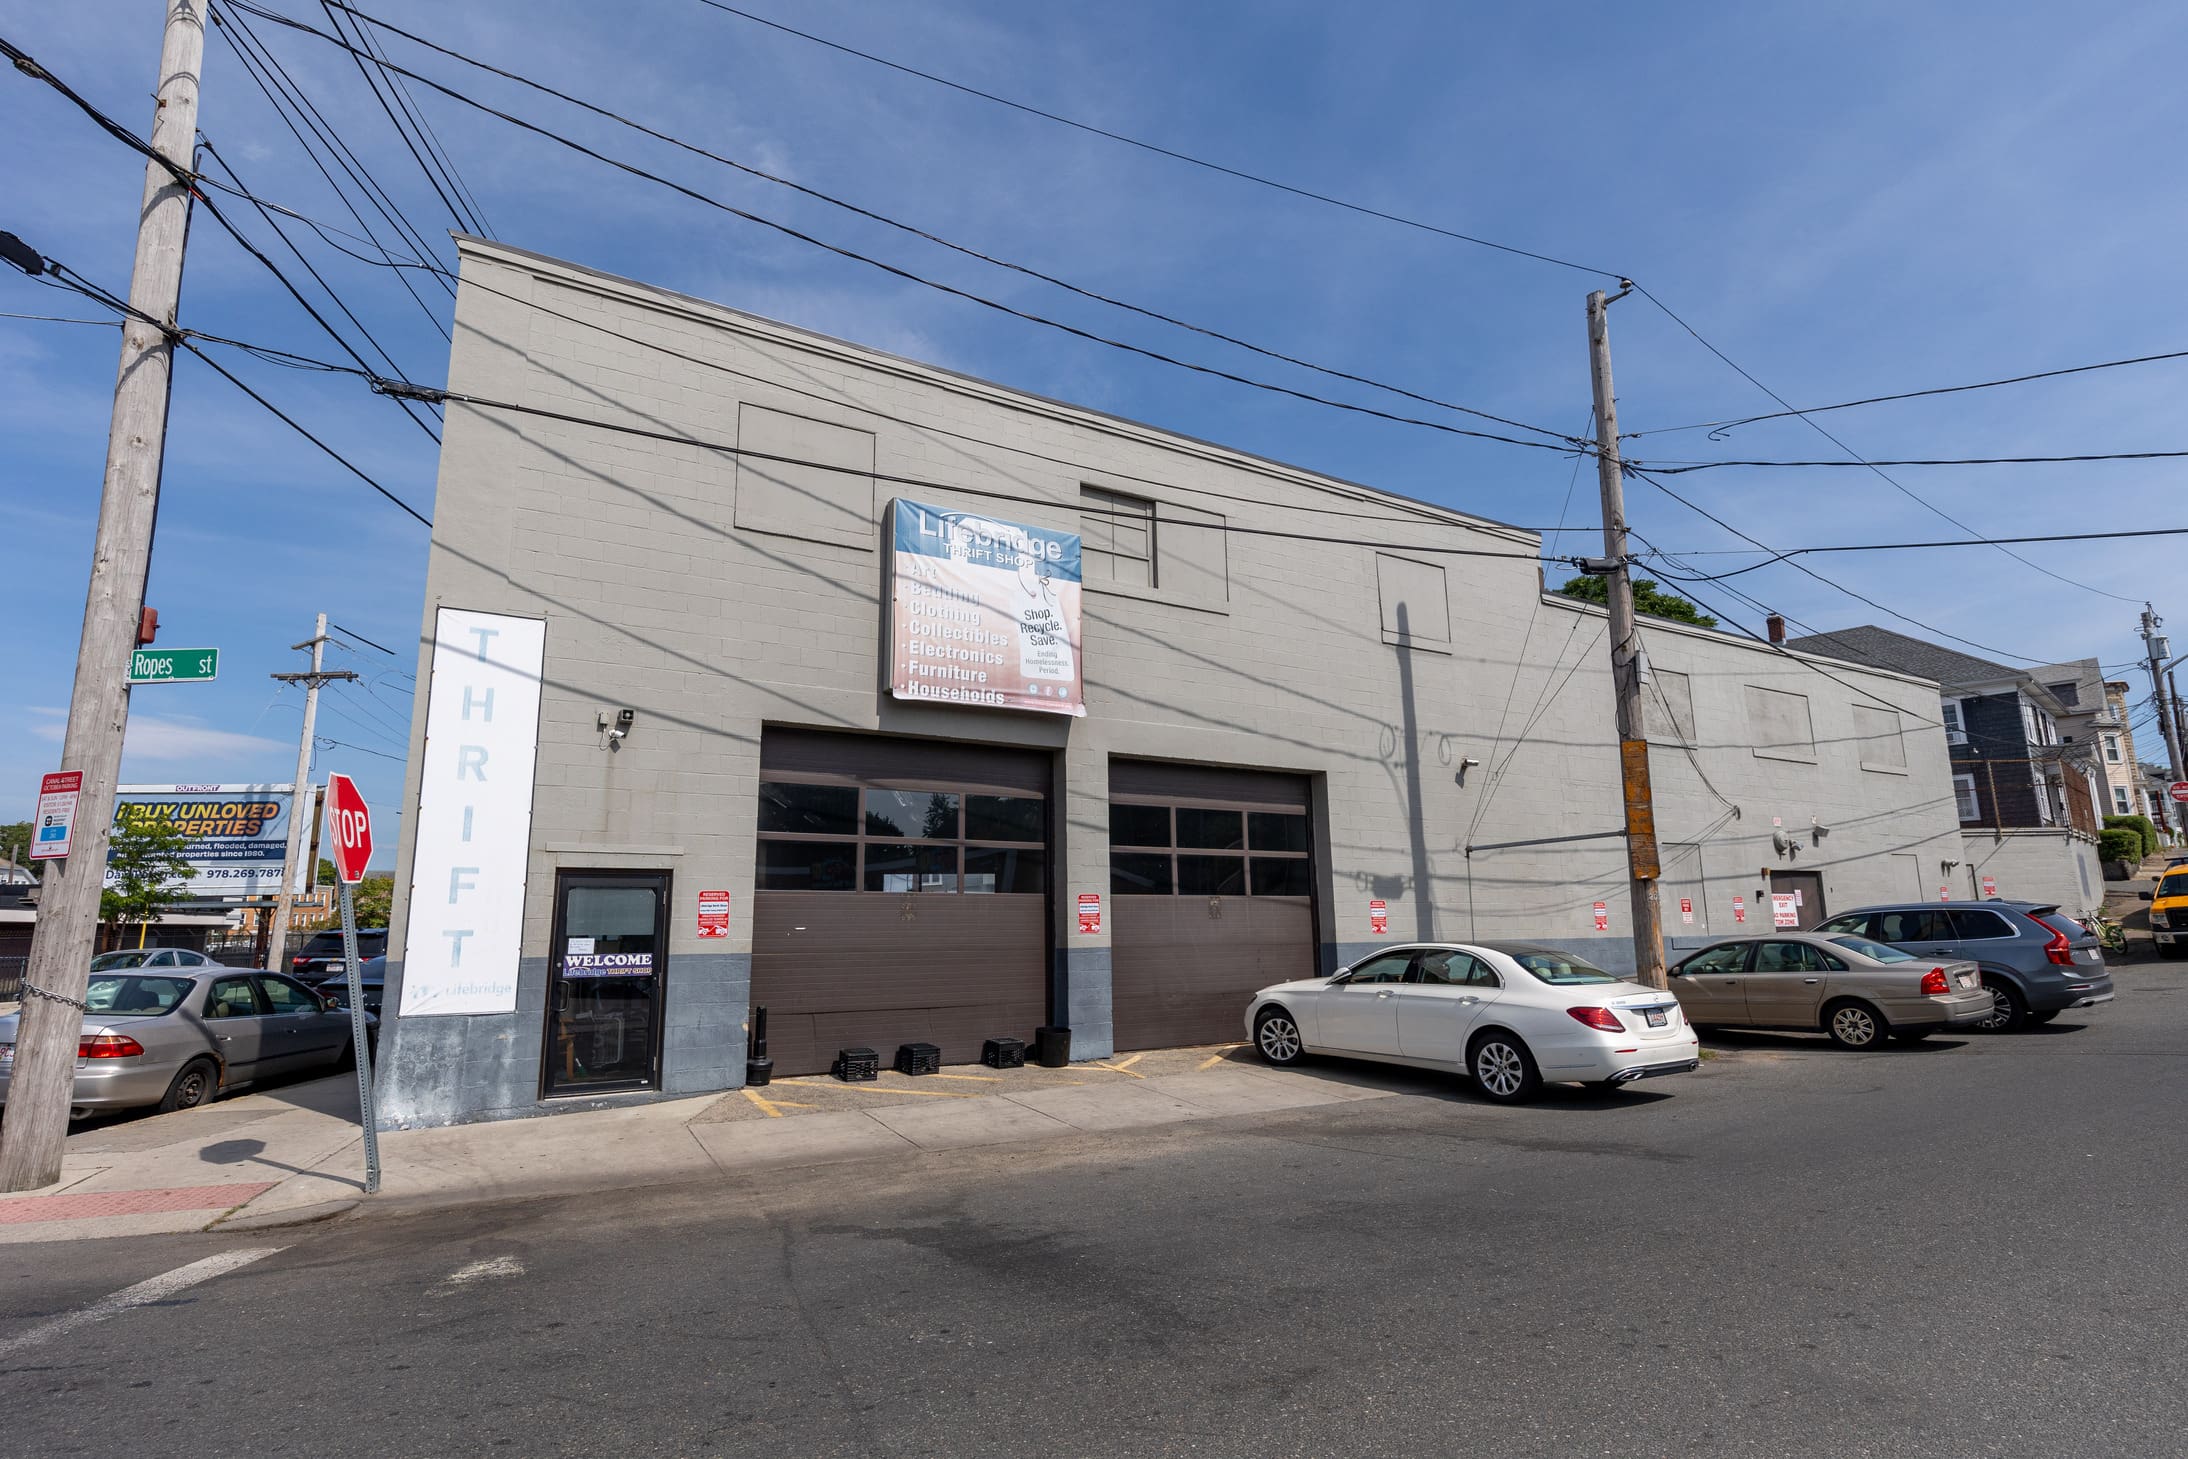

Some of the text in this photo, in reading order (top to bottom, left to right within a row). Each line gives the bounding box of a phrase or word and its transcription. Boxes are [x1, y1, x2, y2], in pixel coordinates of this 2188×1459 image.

[919, 509, 1063, 561] Lifebridge
[943, 542, 1034, 569] THRIFT SHOP
[912, 562, 937, 579] Art
[911, 582, 981, 606] Bedding
[910, 601, 982, 626] Clothing
[1024, 609, 1054, 624] Shop.
[909, 620, 1009, 647] Collectibles
[1020, 621, 1063, 636] Recycle.
[1031, 634, 1058, 647] Save.
[909, 641, 1004, 666] Electronics
[1037, 650, 1058, 660] Ending
[134, 653, 212, 679] Ropes st
[908, 660, 988, 683] Furniture
[907, 680, 1005, 704] Households
[442, 626, 499, 968] THRIFT
[130, 804, 177, 820] BUY
[179, 803, 278, 819] UNLOVED
[329, 806, 367, 849] STOP
[564, 954, 653, 967] WELCOME
